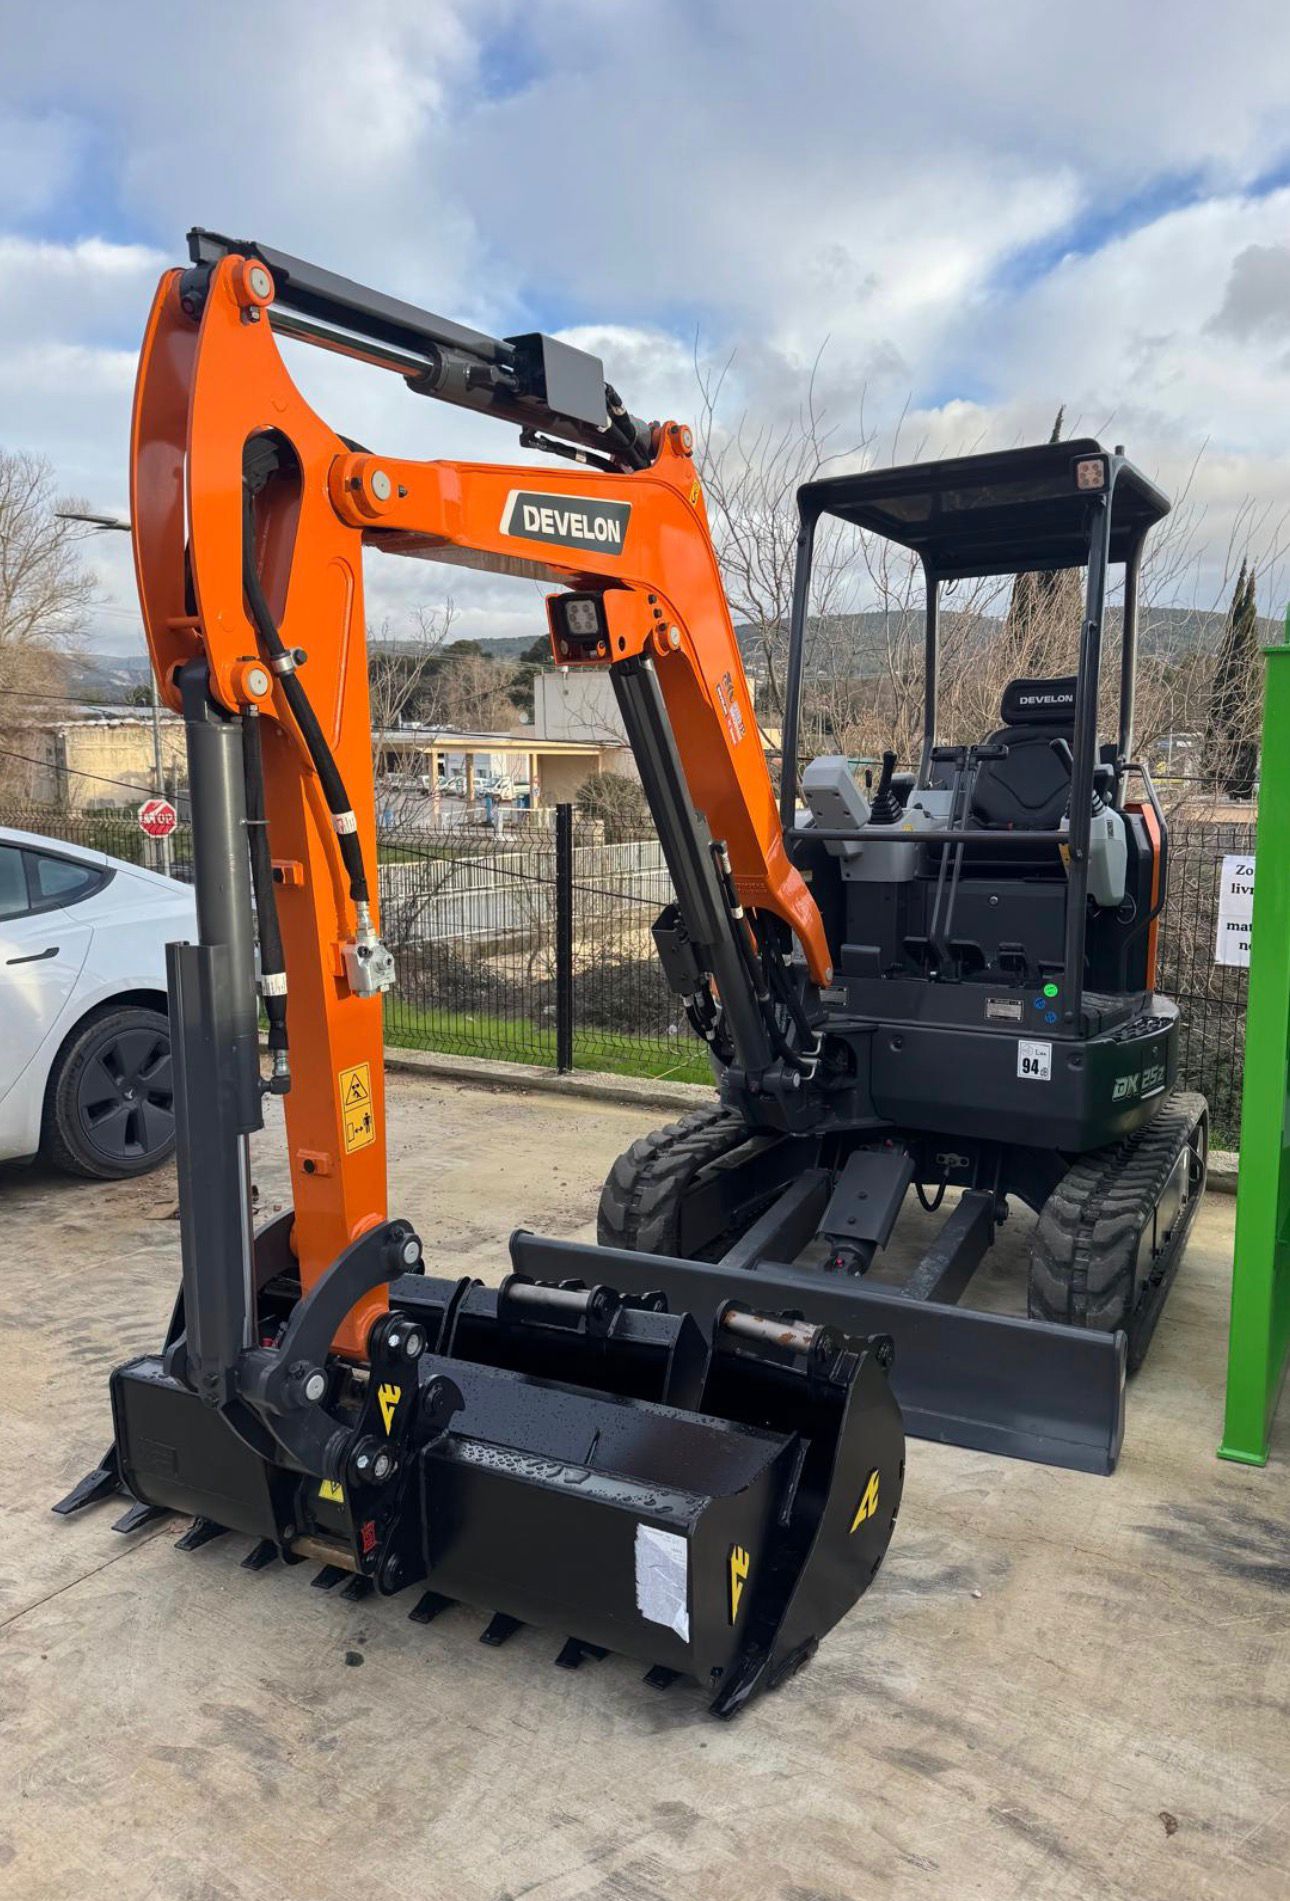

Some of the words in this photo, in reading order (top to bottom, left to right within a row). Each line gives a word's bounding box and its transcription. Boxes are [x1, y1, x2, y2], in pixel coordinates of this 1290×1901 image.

[522, 504, 621, 543] DEVELON
[1019, 694, 1073, 705] DEVELON
[1022, 1057, 1040, 1075] 94
